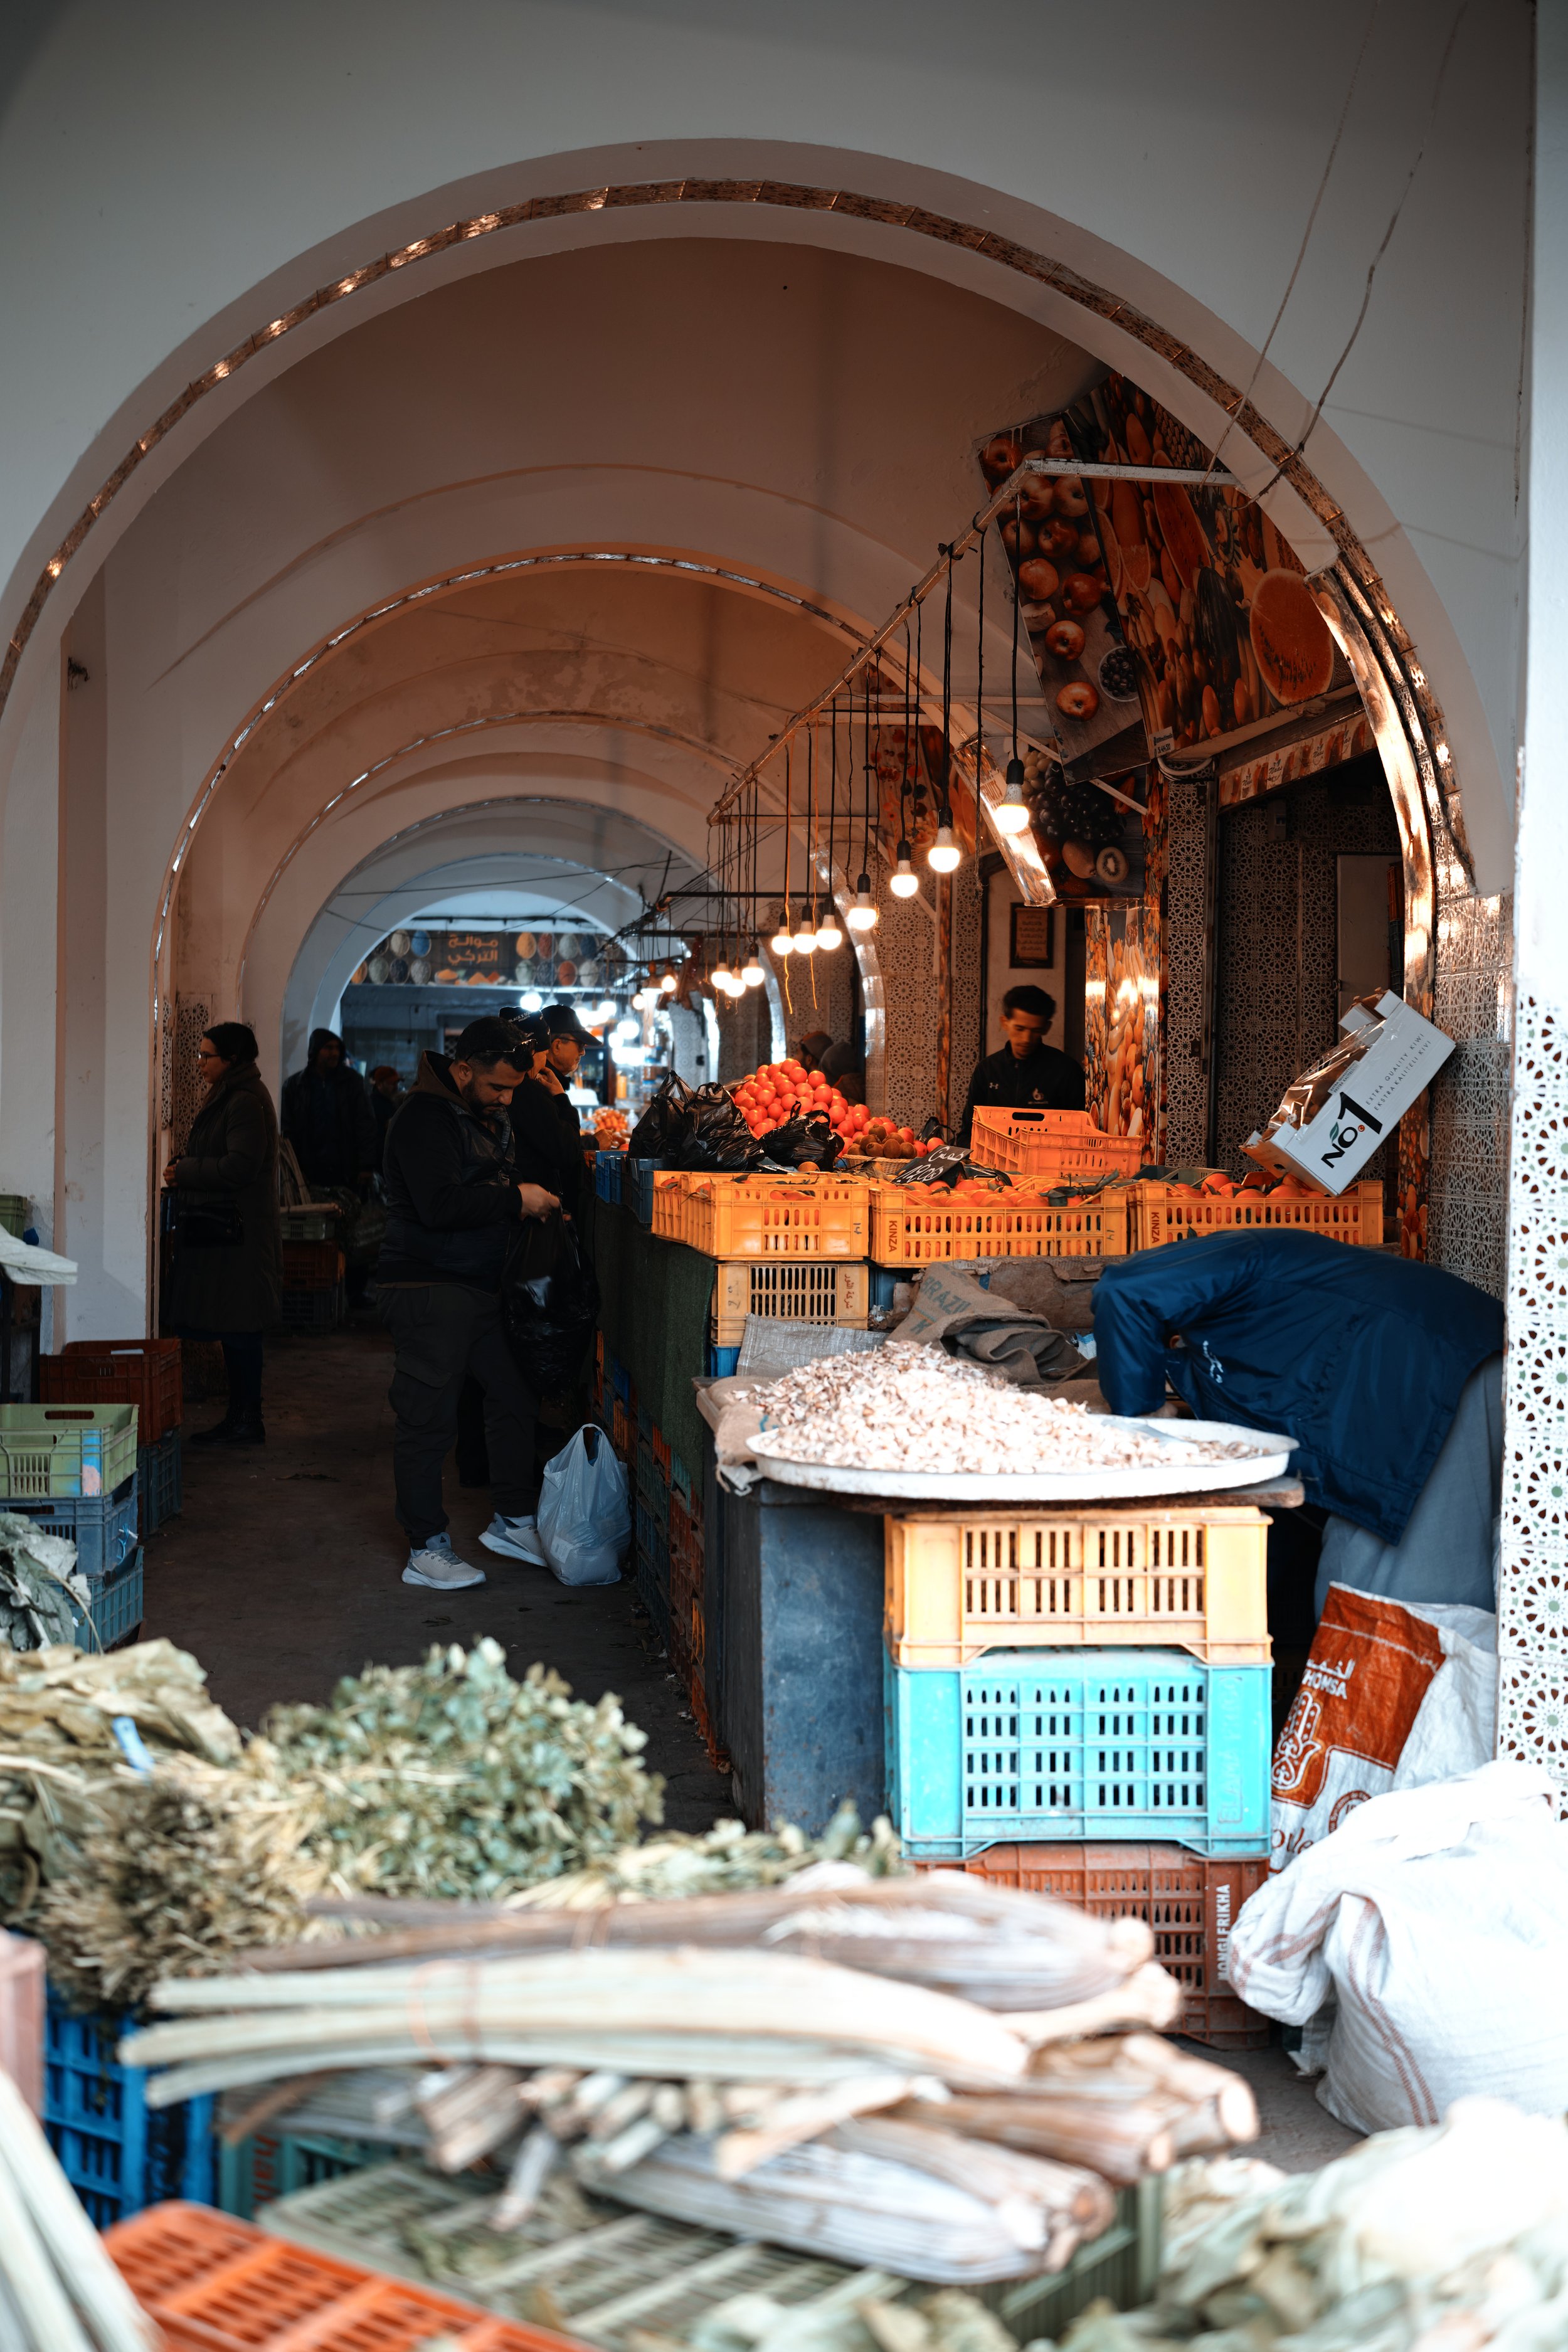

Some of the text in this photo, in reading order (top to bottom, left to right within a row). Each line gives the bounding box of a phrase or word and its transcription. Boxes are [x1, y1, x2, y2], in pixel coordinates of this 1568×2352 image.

[1365, 1033, 1424, 1105] EXTRA QUALITY KIWI
[1374, 1041, 1431, 1111] EKSTRA KALITELI KIVI
[889, 1221, 898, 1253] KINZA
[1151, 1212, 1160, 1244] KINZA
[844, 1291, 854, 1309] شركة
[1301, 1669, 1348, 1700] HOMSA
[1216, 1883, 1231, 1935] FRIKHA
